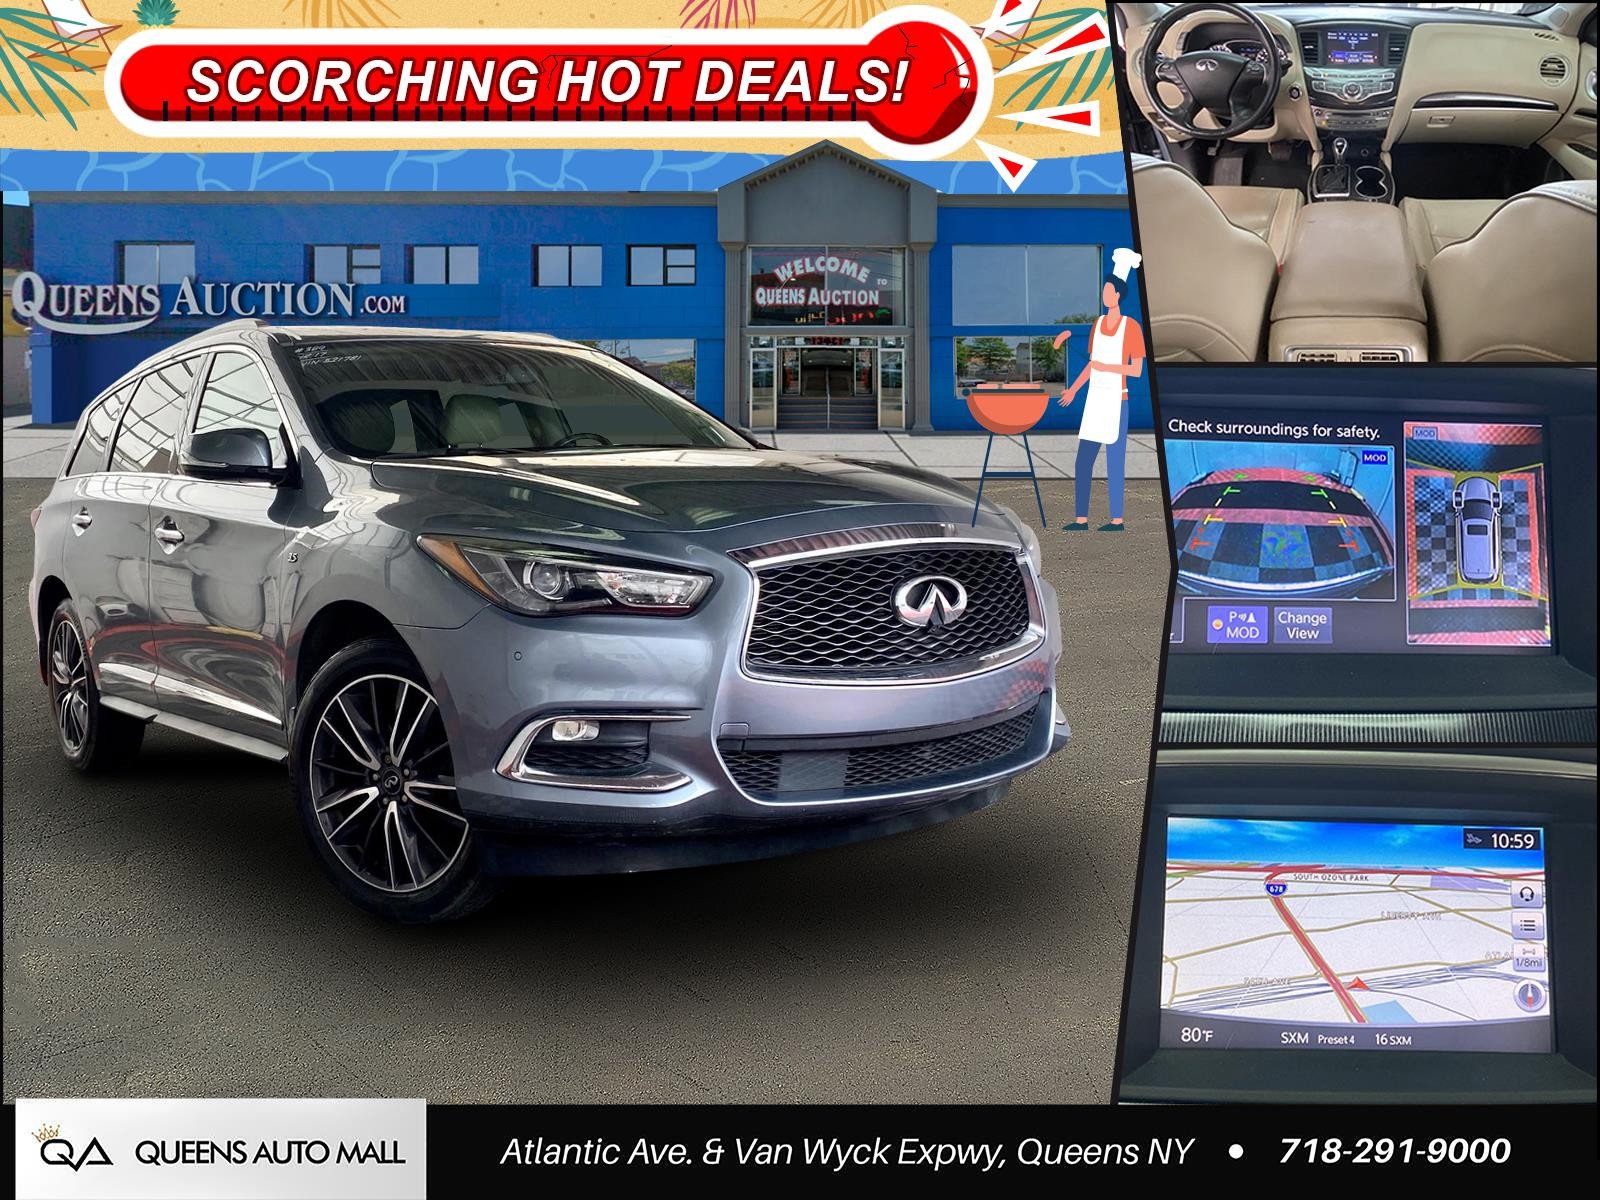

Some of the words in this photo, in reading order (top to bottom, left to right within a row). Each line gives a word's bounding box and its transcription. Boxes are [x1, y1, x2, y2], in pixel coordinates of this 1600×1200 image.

[774, 256, 871, 283] WELCOME
[877, 278, 888, 286] TO
[12, 271, 160, 335] QUEENS
[755, 287, 806, 307] QUEENS
[808, 287, 880, 306] AUCTION
[1168, 419, 1212, 433] Check
[1216, 422, 1309, 438] surroundings
[1313, 423, 1333, 437] for
[1337, 425, 1380, 441] safety.
[1363, 453, 1387, 463] MOD
[1278, 611, 1328, 628] Change
[1226, 627, 1260, 639] MOD
[1287, 628, 1320, 640] View
[1491, 833, 1535, 849] 10:59
[1350, 874, 1370, 882] PARK
[1269, 885, 1284, 894] 678
[1516, 957, 1543, 968] 1/8mi
[1280, 1032, 1309, 1044] SXM
[1318, 1035, 1348, 1045] Preset
[1349, 1035, 1355, 1044] 4
[1375, 1033, 1388, 1045] 16
[1390, 1035, 1412, 1046] SXM
